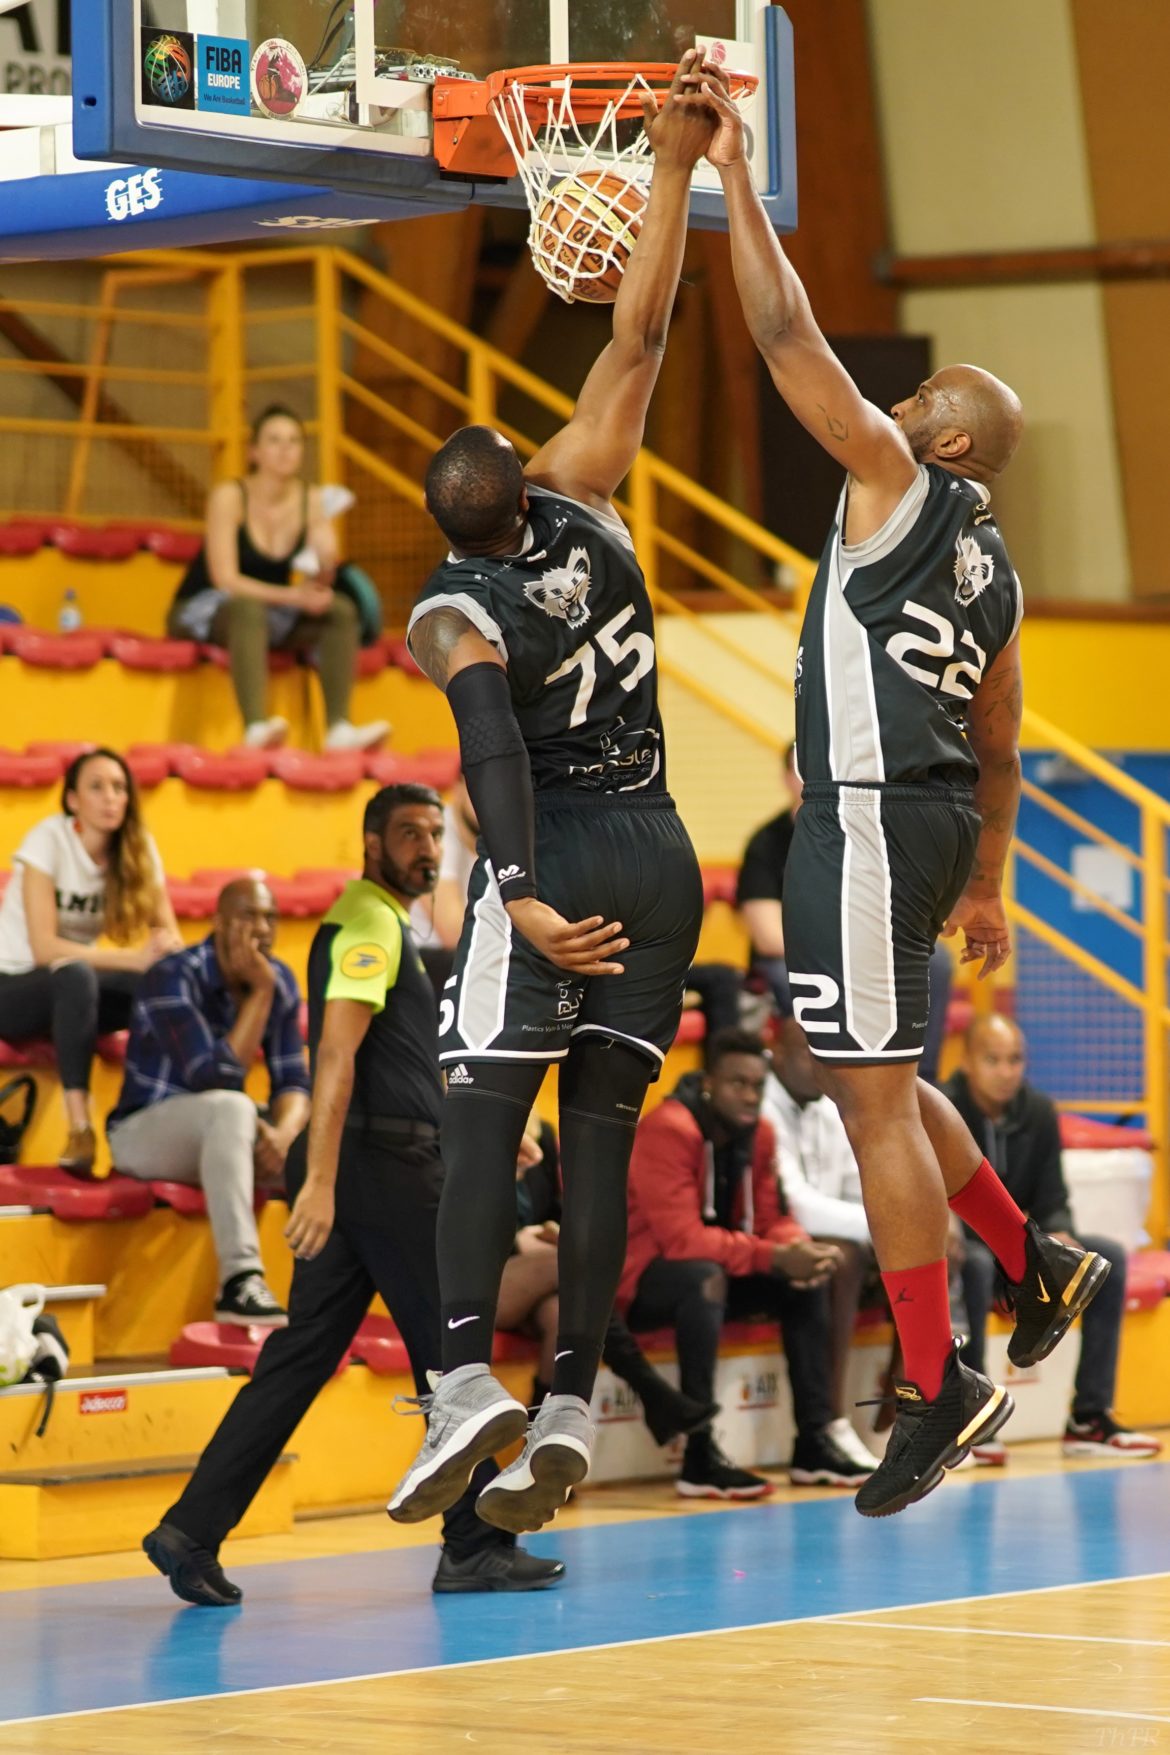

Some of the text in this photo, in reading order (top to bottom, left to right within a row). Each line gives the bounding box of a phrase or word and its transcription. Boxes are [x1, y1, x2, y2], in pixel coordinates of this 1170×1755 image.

[206, 46, 242, 74] FIBA
[208, 73, 241, 89] EUROPE
[105, 168, 162, 221] GES
[544, 603, 655, 729] 75
[885, 600, 986, 700] 22
[788, 972, 840, 1033] 2
